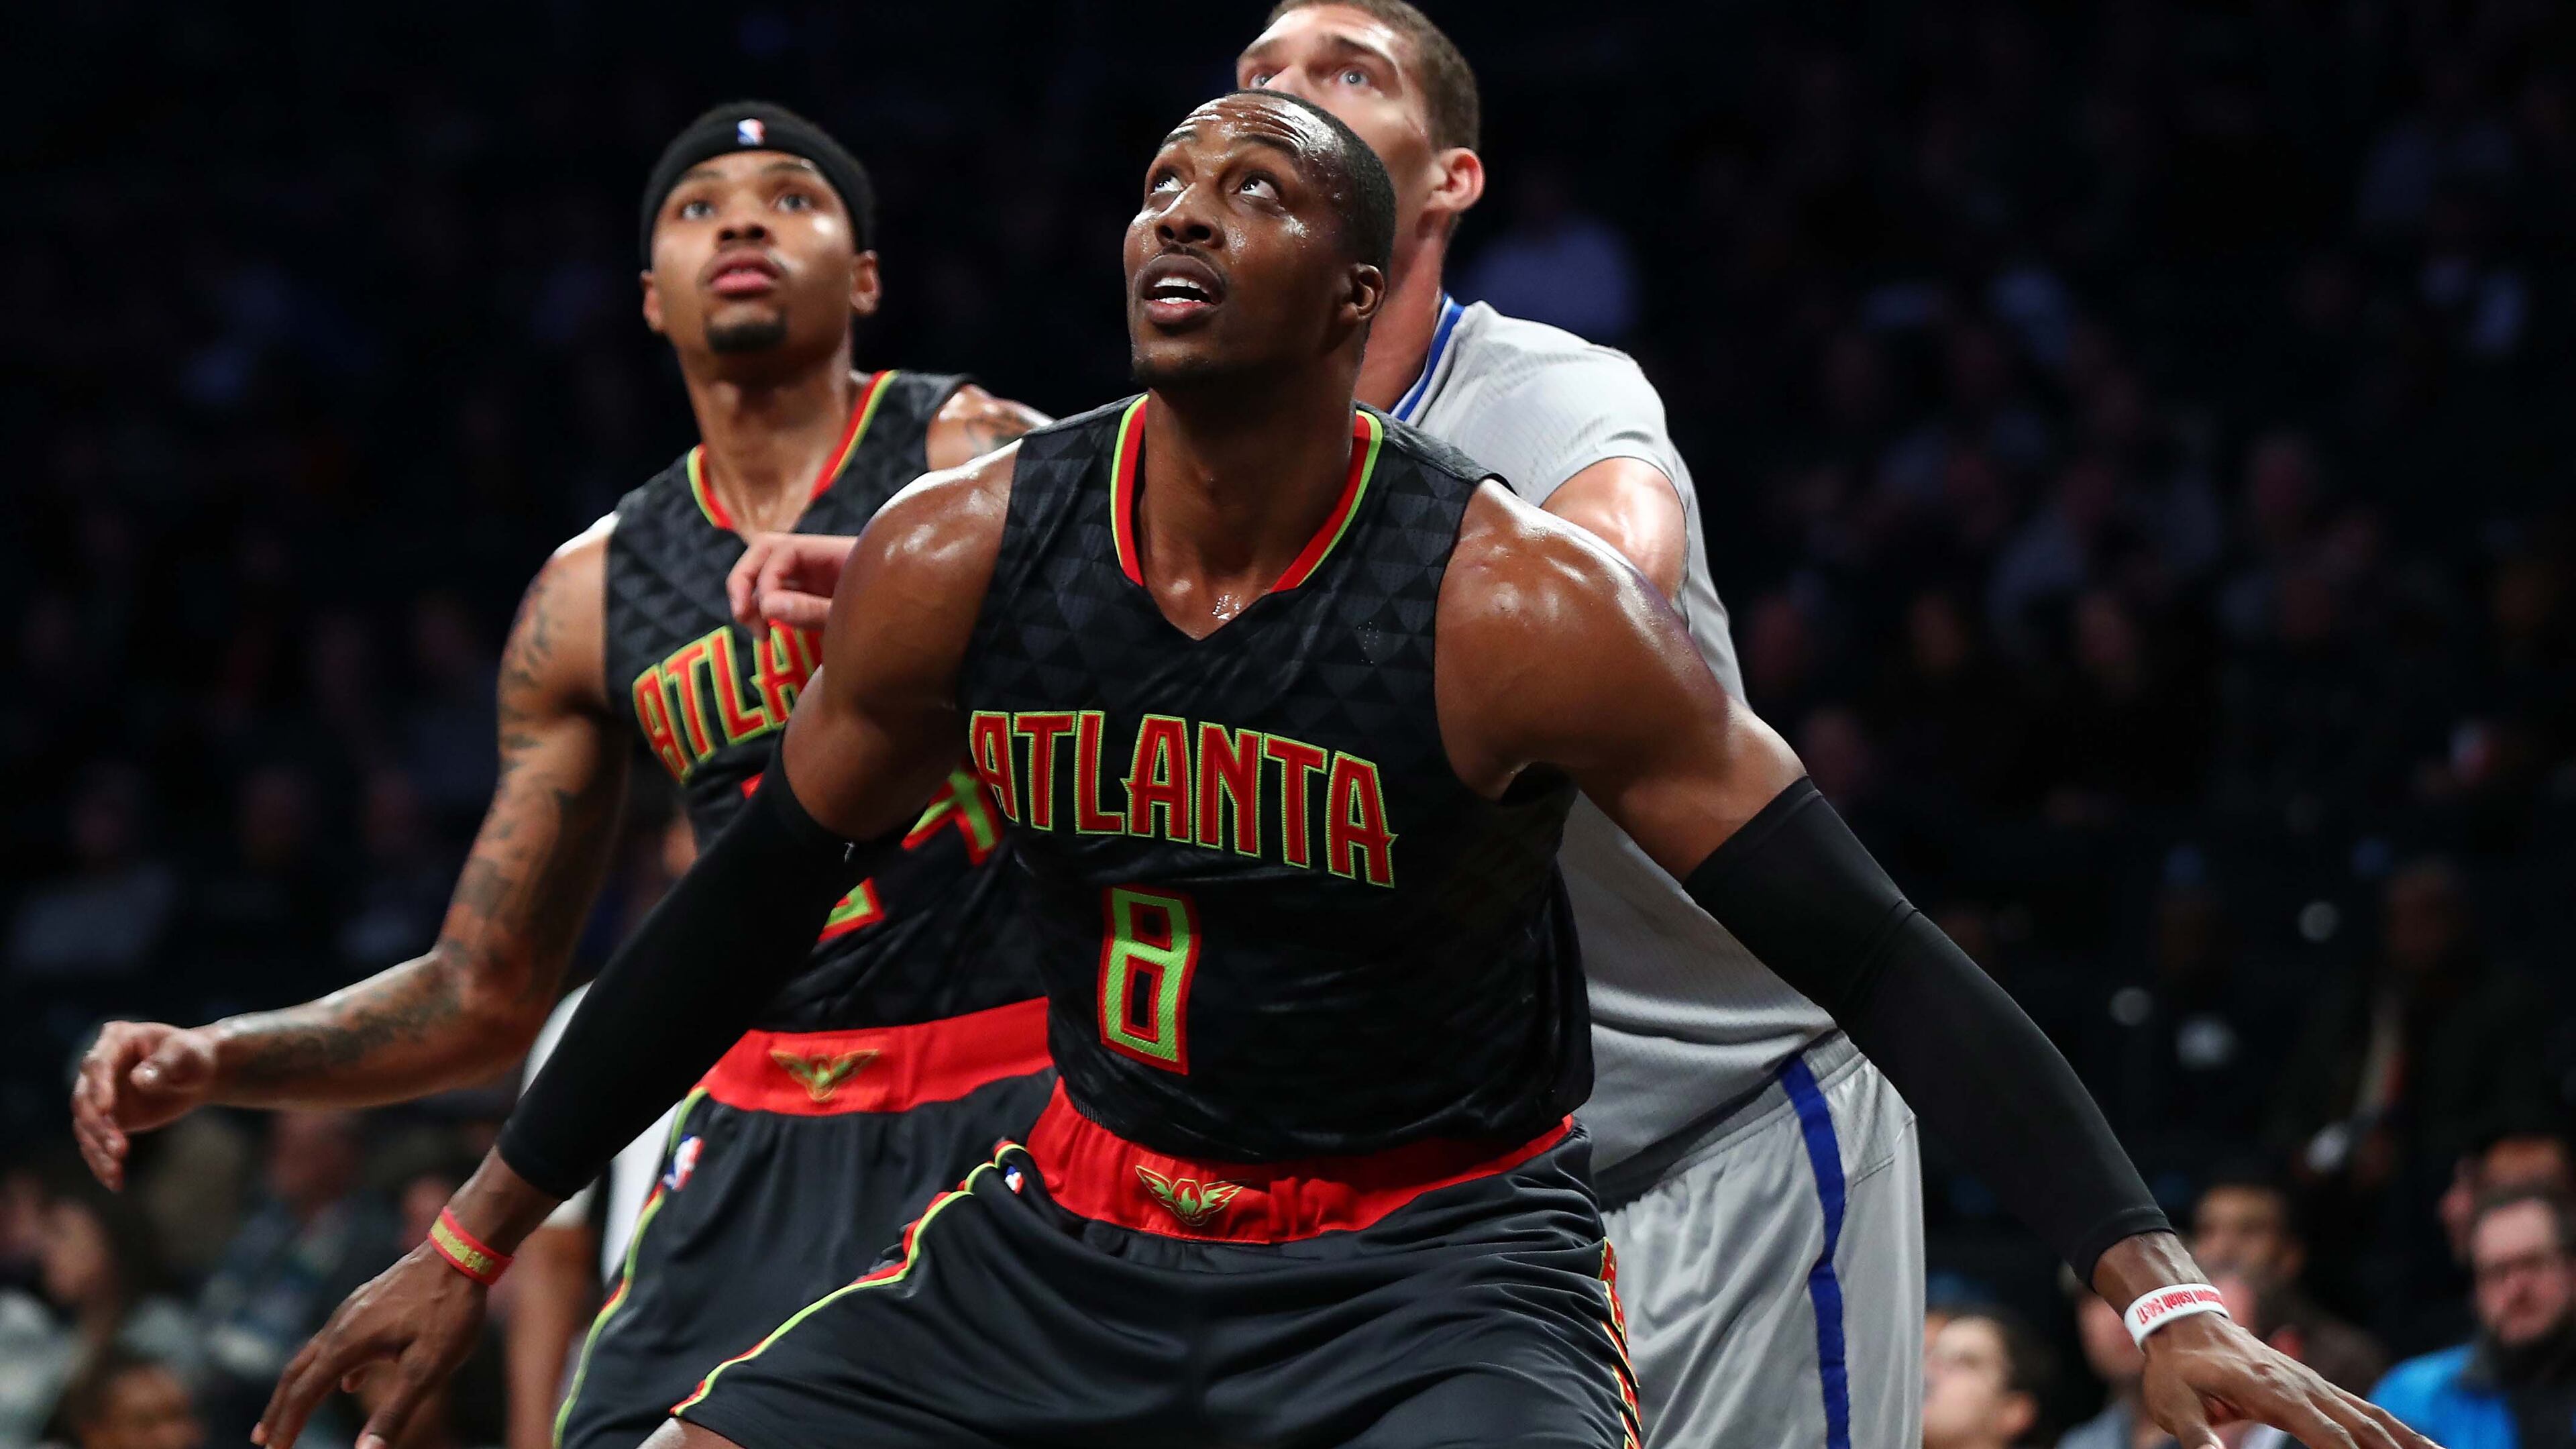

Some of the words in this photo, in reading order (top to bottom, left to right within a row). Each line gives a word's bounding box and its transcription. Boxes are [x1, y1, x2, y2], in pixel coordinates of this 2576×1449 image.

[633, 618, 824, 787] ATLA
[969, 709, 1399, 889] ATLANTA
[1097, 884, 1202, 1075] 8
